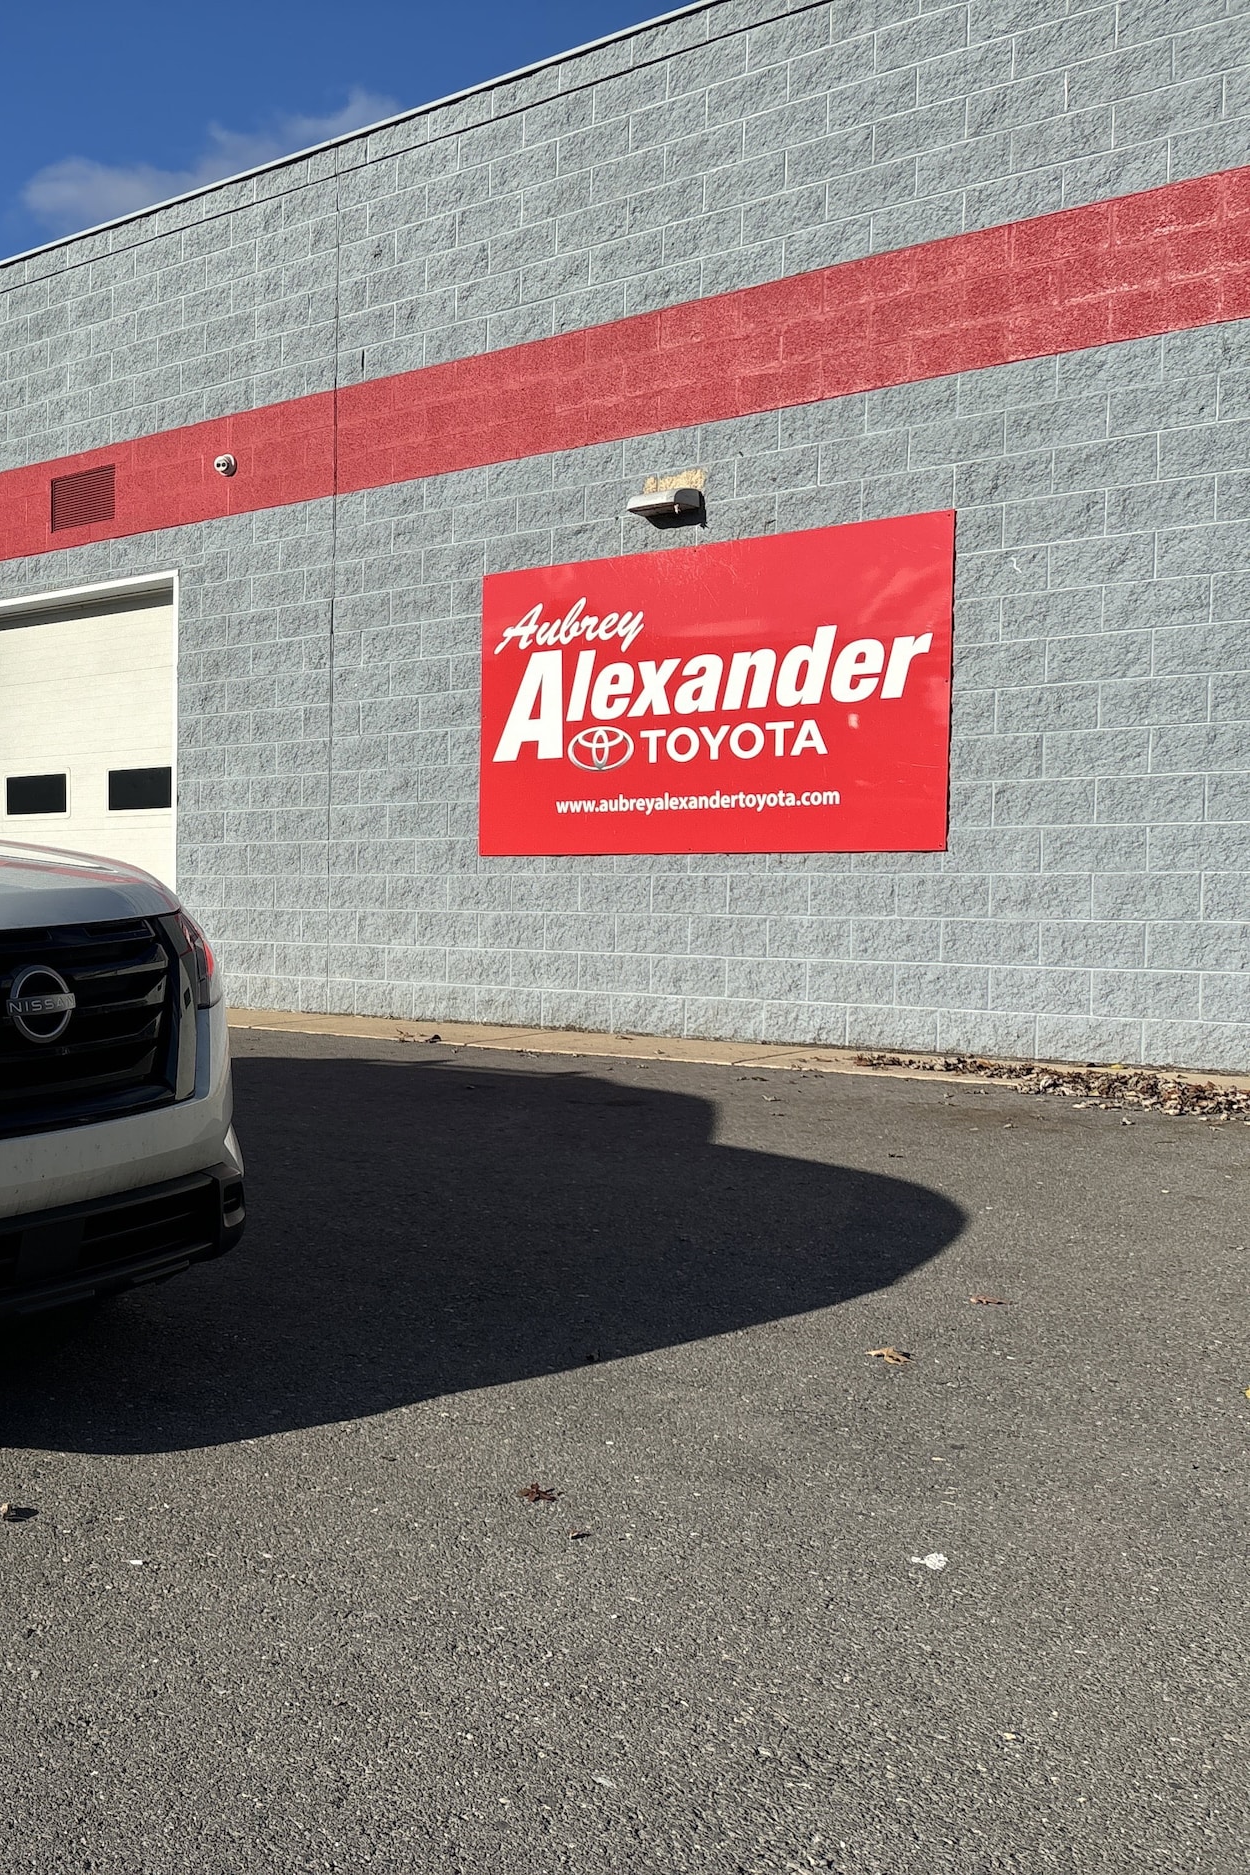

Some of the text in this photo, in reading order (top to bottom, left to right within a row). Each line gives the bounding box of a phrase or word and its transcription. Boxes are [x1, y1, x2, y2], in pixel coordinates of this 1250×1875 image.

[494, 596, 645, 655] Aubrey
[492, 624, 934, 763] Alexander
[640, 719, 828, 764] TOYOTA
[555, 788, 841, 816] www.aubreyalexandertoyota.com
[8, 994, 76, 1014] NISSAN
